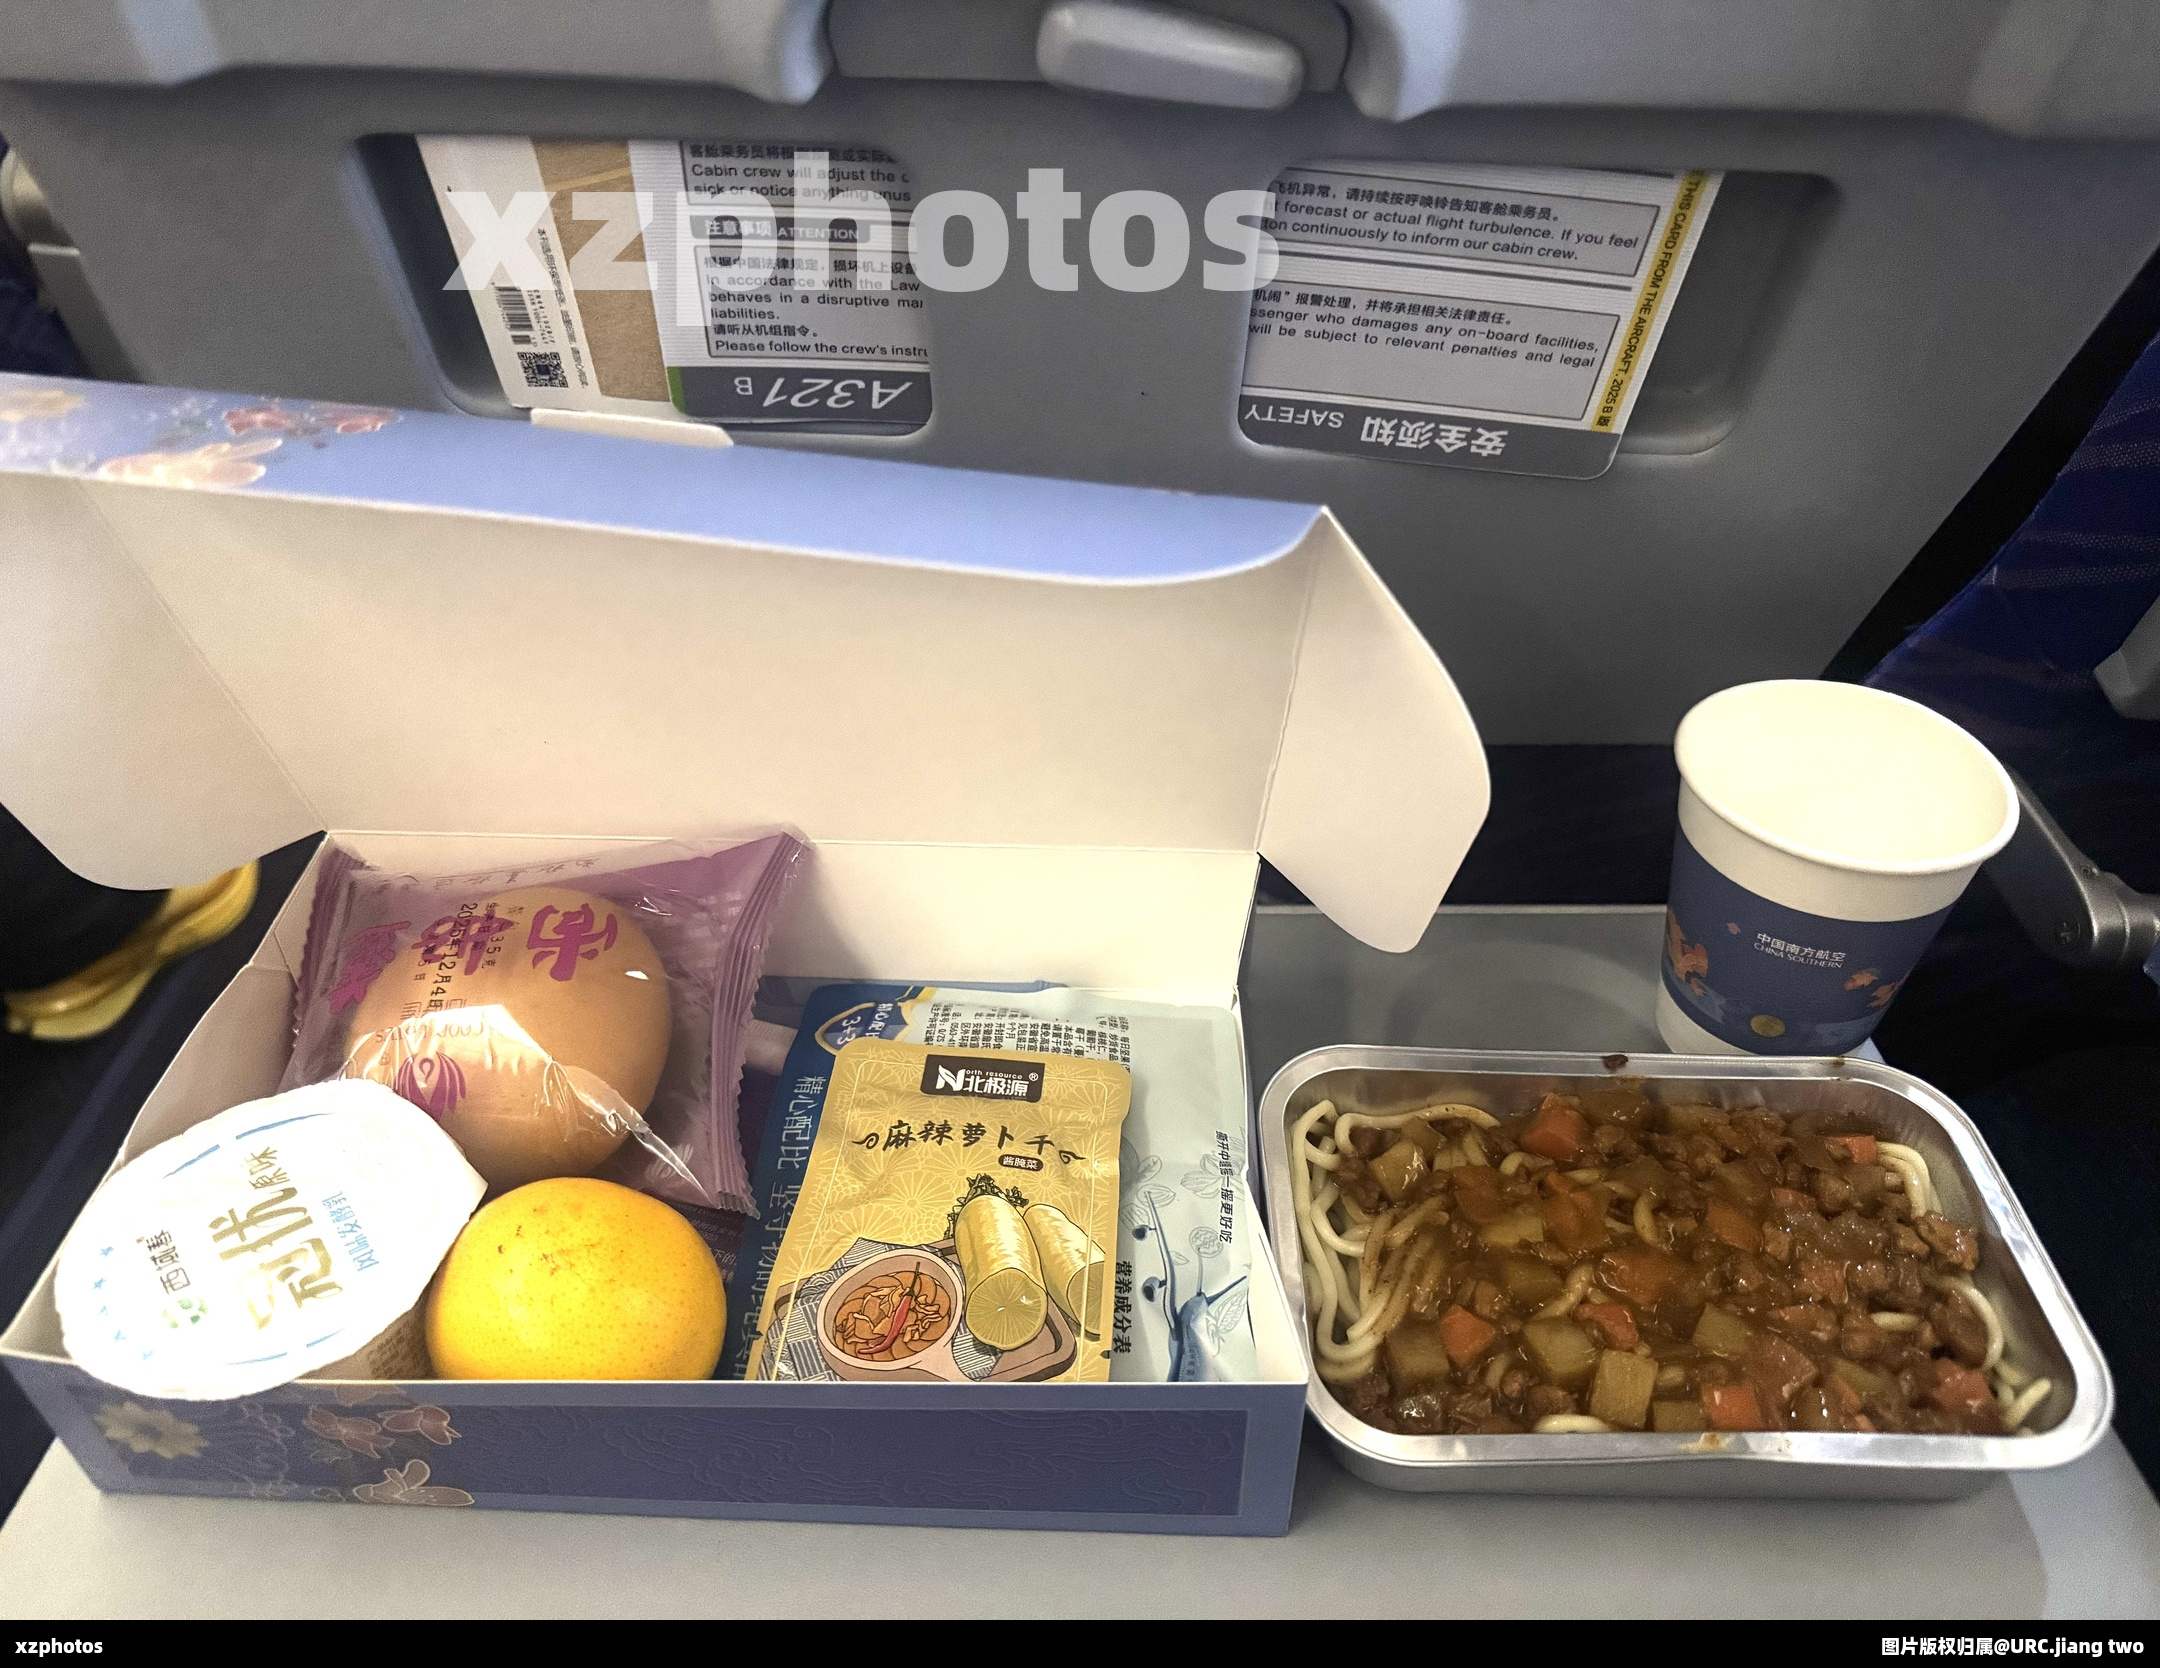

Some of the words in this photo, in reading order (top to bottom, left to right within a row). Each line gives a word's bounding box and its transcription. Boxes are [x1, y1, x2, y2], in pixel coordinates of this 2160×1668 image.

[692, 164, 738, 177] Cabin
[743, 168, 781, 178] crew
[786, 166, 811, 179] will
[817, 167, 865, 182] adjust
[870, 169, 895, 183] the
[694, 183, 725, 195] sick
[729, 185, 746, 196] or
[750, 183, 797, 197] notice
[802, 186, 869, 203] anything
[1678, 180, 1701, 211] THIS
[704, 219, 772, 237] 注意事项
[778, 227, 859, 240] ATTENTION
[1284, 200, 1348, 219] forecast
[1352, 209, 1370, 221] or
[1373, 210, 1422, 226] actual
[1425, 213, 1463, 231] flight
[1468, 219, 1555, 240] turbulence.
[1560, 229, 1573, 241] If
[1574, 232, 1604, 245] you
[1608, 233, 1640, 249] feel
[1664, 212, 1687, 249] CARD
[1292, 222, 1389, 242] continuously
[1392, 230, 1408, 243] to
[1410, 230, 1460, 248] inform
[1463, 239, 1490, 250] our
[1492, 241, 1534, 256] cabin
[1537, 247, 1579, 261] crew.
[706, 274, 720, 286] In
[727, 274, 815, 288] accordance
[822, 276, 853, 290] with
[859, 277, 884, 291] the
[890, 280, 921, 292] Law
[1649, 251, 1673, 290] FROM
[710, 291, 772, 304] behaves
[780, 292, 793, 304] in
[800, 294, 810, 304] a
[817, 293, 890, 308] disruptive
[1639, 291, 1658, 315] THE
[710, 308, 780, 320] liabilities.
[1249, 323, 1273, 335] will
[1278, 325, 1297, 337] be
[1304, 328, 1358, 343] subject
[1364, 333, 1379, 344] to
[1385, 335, 1445, 351] relevant
[1450, 342, 1518, 360] penalties
[1524, 351, 1554, 363] and
[1559, 353, 1597, 369] legal
[1316, 313, 1345, 325] who
[1351, 316, 1418, 333] damages
[1425, 325, 1454, 337] any
[1458, 327, 1530, 344] on-board
[1535, 333, 1600, 354] facilities,
[715, 340, 765, 352] Please
[769, 340, 811, 353] follow
[815, 342, 839, 354] the
[841, 343, 888, 355] crew's
[733, 376, 753, 396] B
[762, 377, 914, 410] A321
[1605, 379, 1624, 405] 2025
[1244, 403, 1346, 429] SAFETY
[1360, 416, 1509, 457] 安全须知
[1753, 942, 1784, 959] CHINA
[1787, 953, 1843, 969] SOUTHERN
[1756, 933, 1847, 962] 中国南方航空
[963, 1075, 1030, 1097] 北极源
[985, 1070, 1023, 1080] resource
[777, 1075, 828, 1171] 精心配比
[882, 1119, 1055, 1156] 麻辣萝卜干
[1002, 1155, 1039, 1170] 酱腌菜
[1112, 1259, 1133, 1354] 营养成分表
